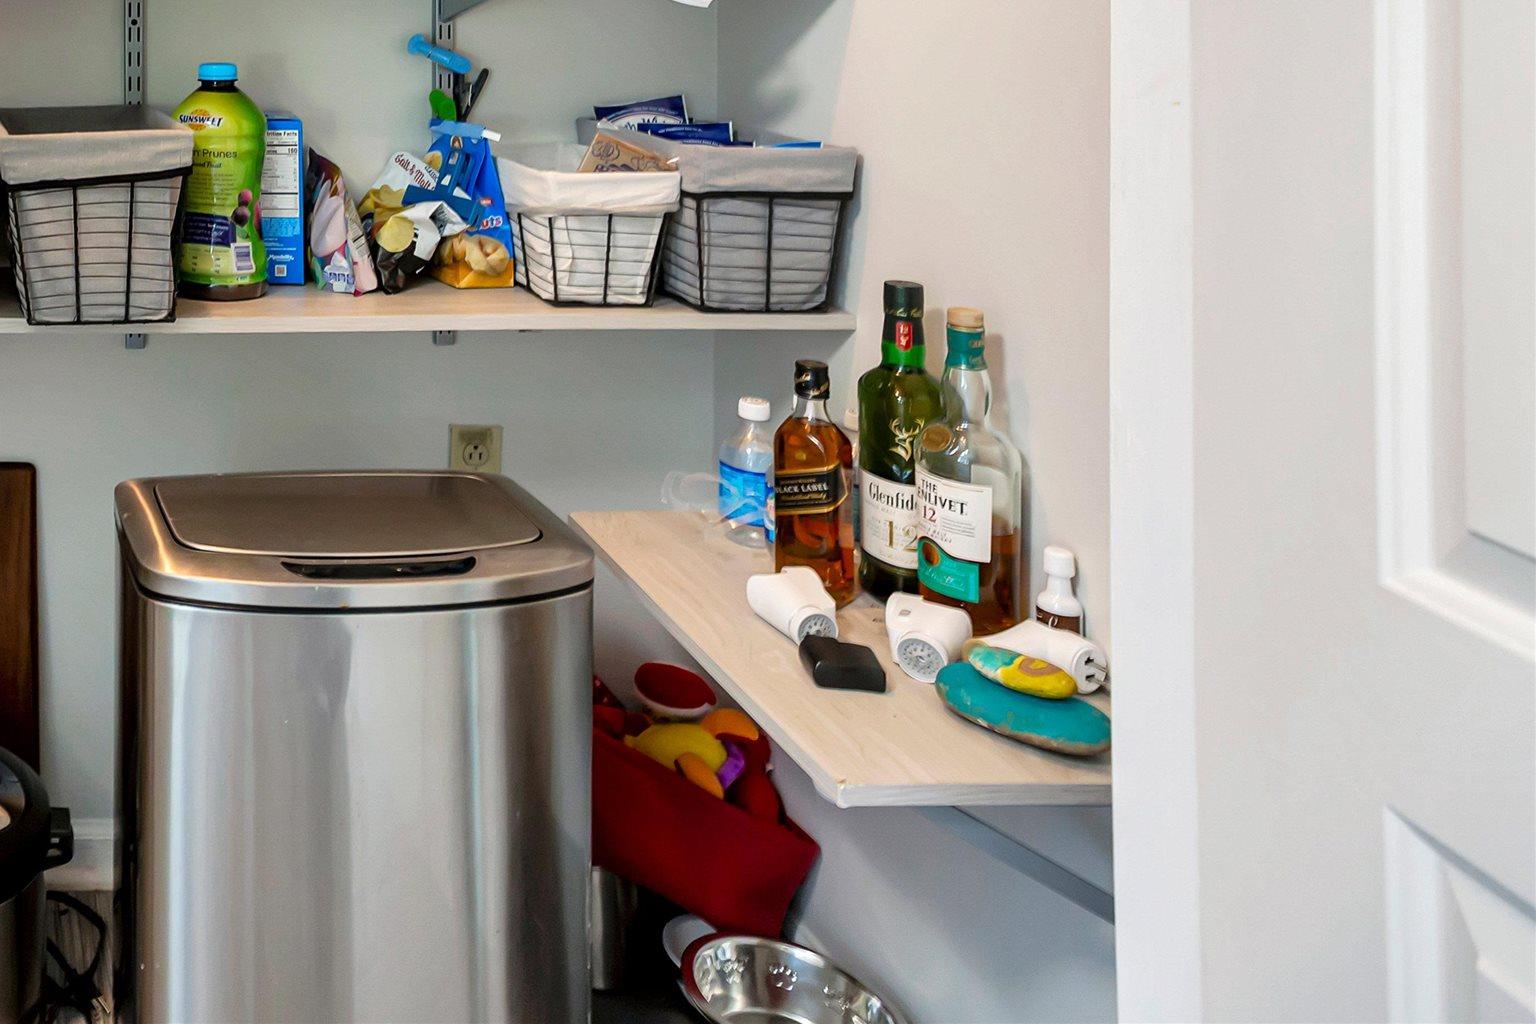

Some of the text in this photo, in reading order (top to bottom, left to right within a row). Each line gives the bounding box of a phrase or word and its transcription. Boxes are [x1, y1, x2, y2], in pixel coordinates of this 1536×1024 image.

[179, 114, 223, 128] SUNSWEET
[202, 148, 238, 159] Prunes
[800, 482, 830, 493] LABEL
[921, 479, 938, 493] THE
[869, 482, 918, 512] Glenfid
[917, 486, 968, 516] ENLIVET
[923, 505, 937, 524] 12
[885, 520, 918, 553] 12
